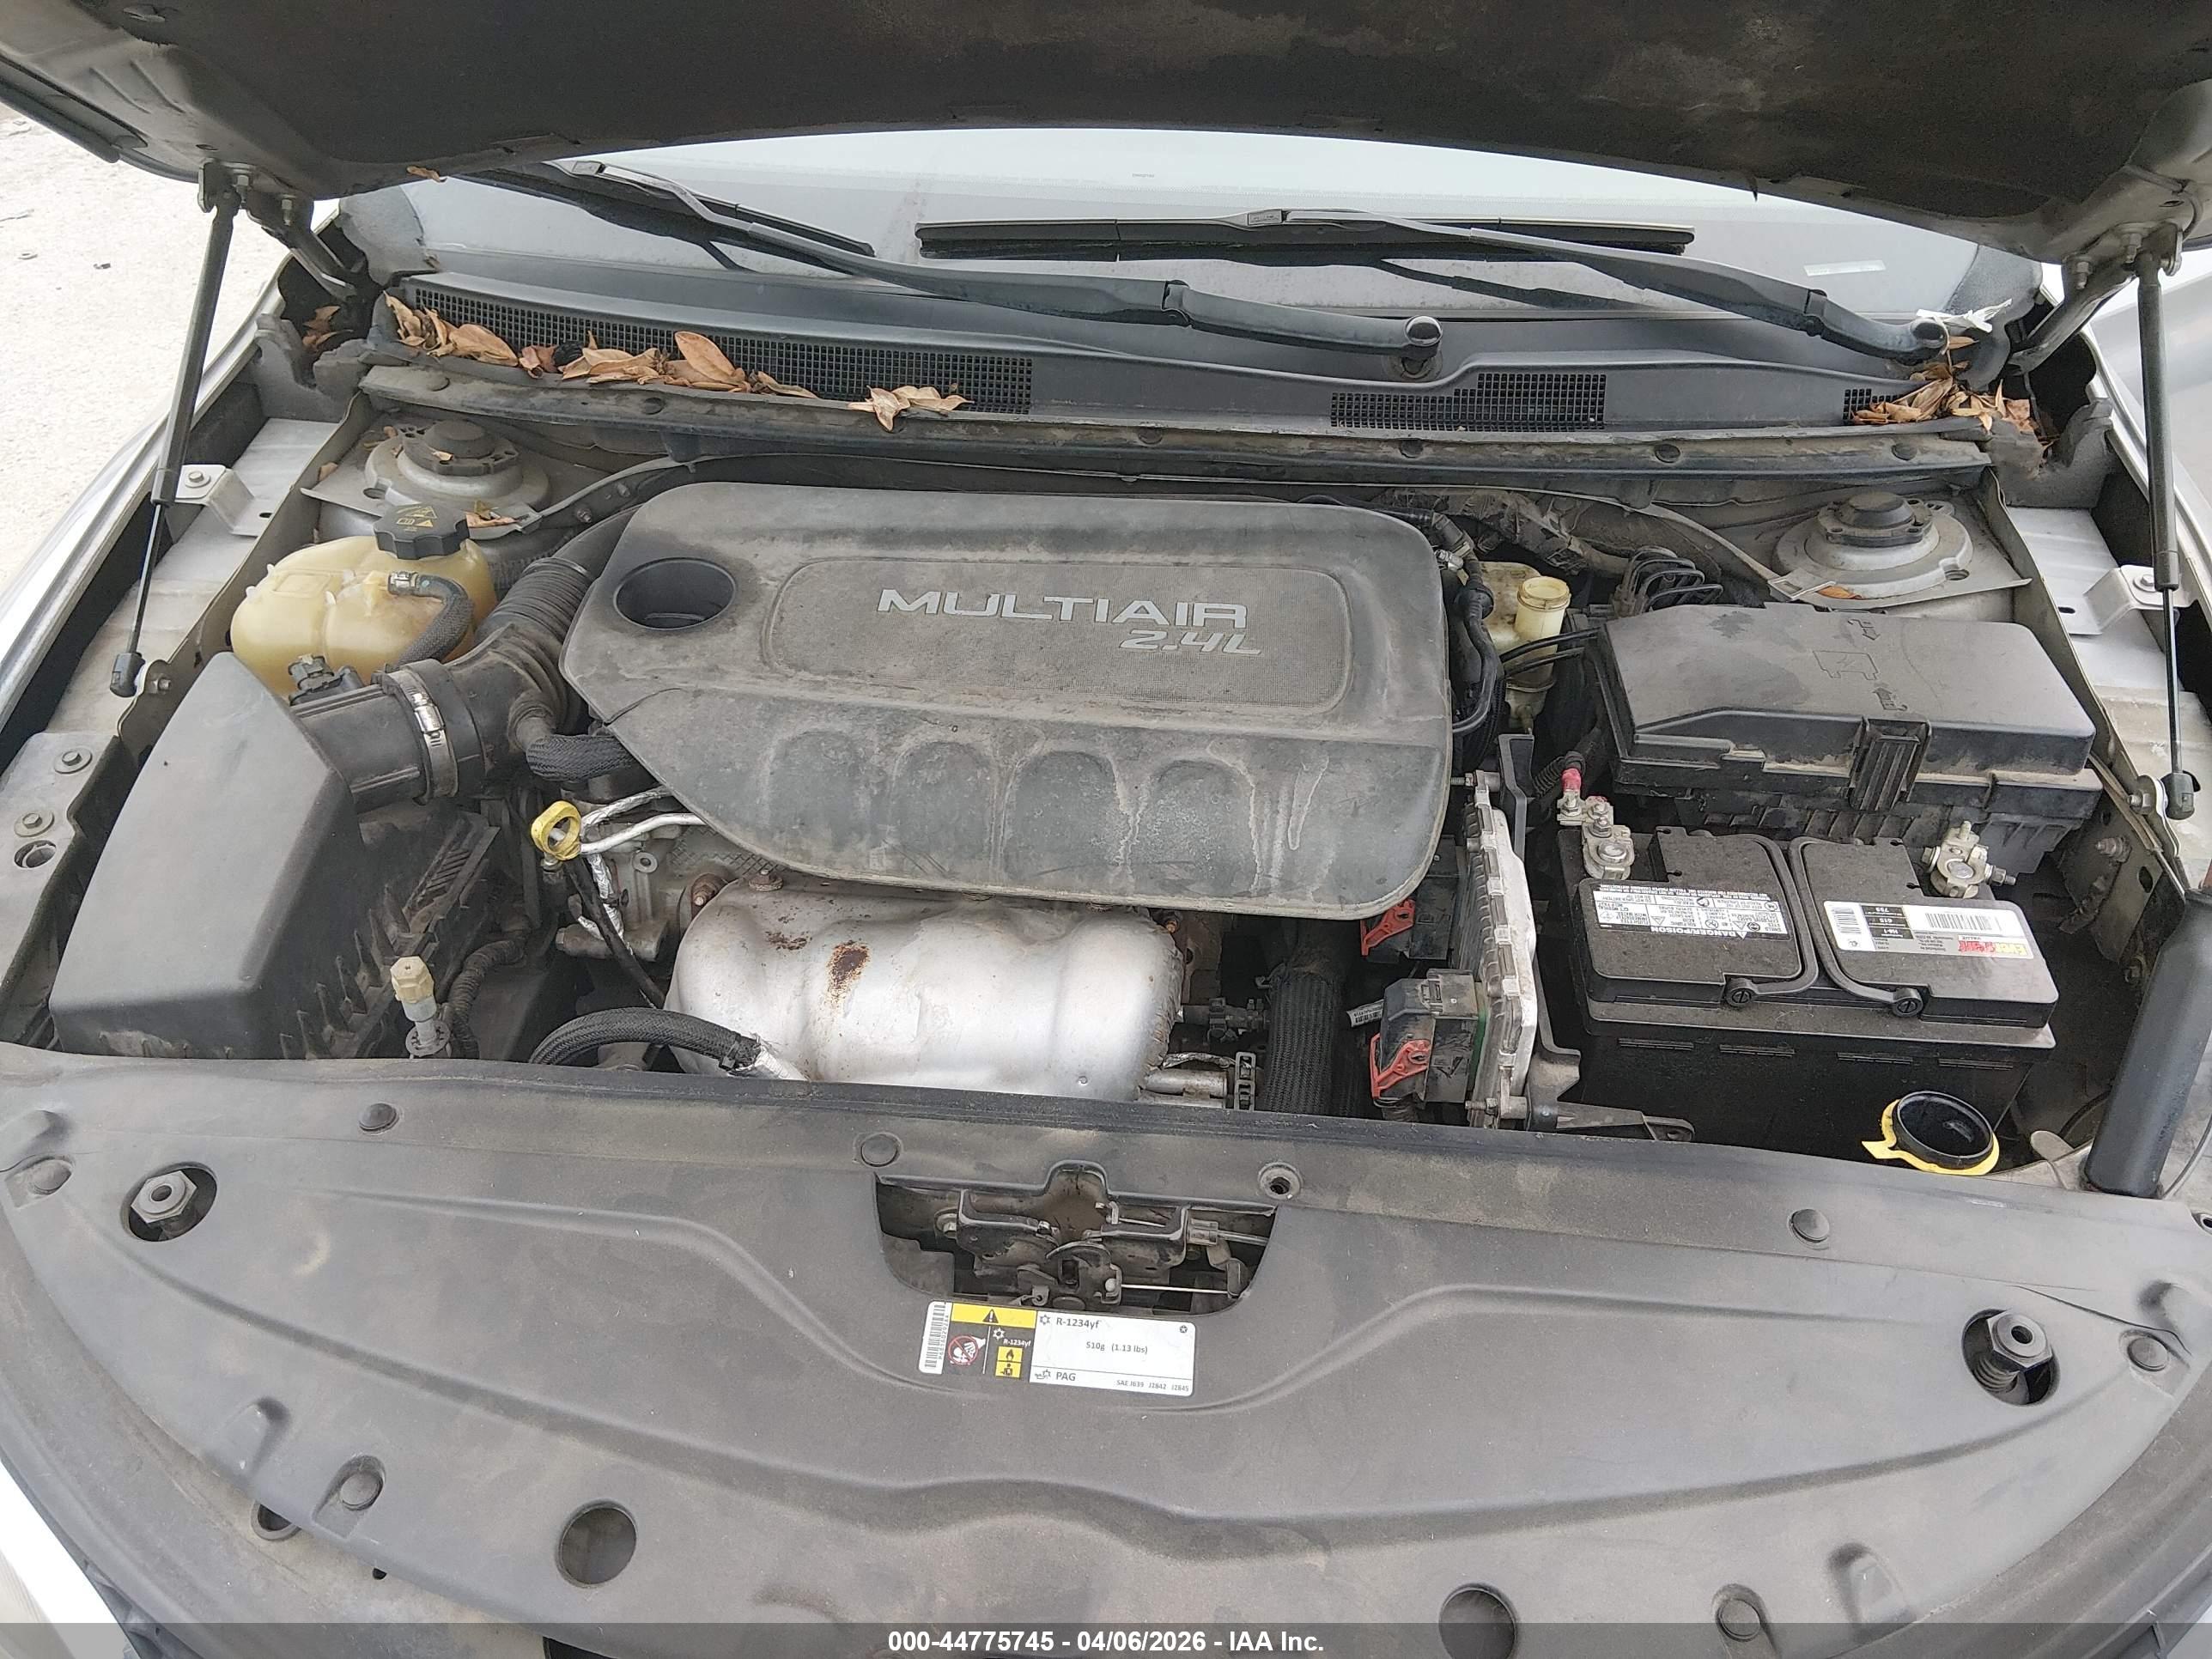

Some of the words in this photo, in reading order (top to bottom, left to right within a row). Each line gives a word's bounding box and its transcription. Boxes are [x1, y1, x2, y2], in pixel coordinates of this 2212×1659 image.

[877, 589, 1248, 629] MULTIAIR
[1119, 629, 1261, 655] 2.4L
[1650, 927, 1735, 936] DANGER/POISON
[1056, 1317, 1099, 1329] R-1234yf
[1003, 1339, 1031, 1348] R-1234yf
[1086, 1341, 1105, 1351] 510g
[1111, 1343, 1132, 1352] (1.13
[1133, 1344, 1148, 1354] lbs)
[1056, 1371, 1076, 1382] PAG
